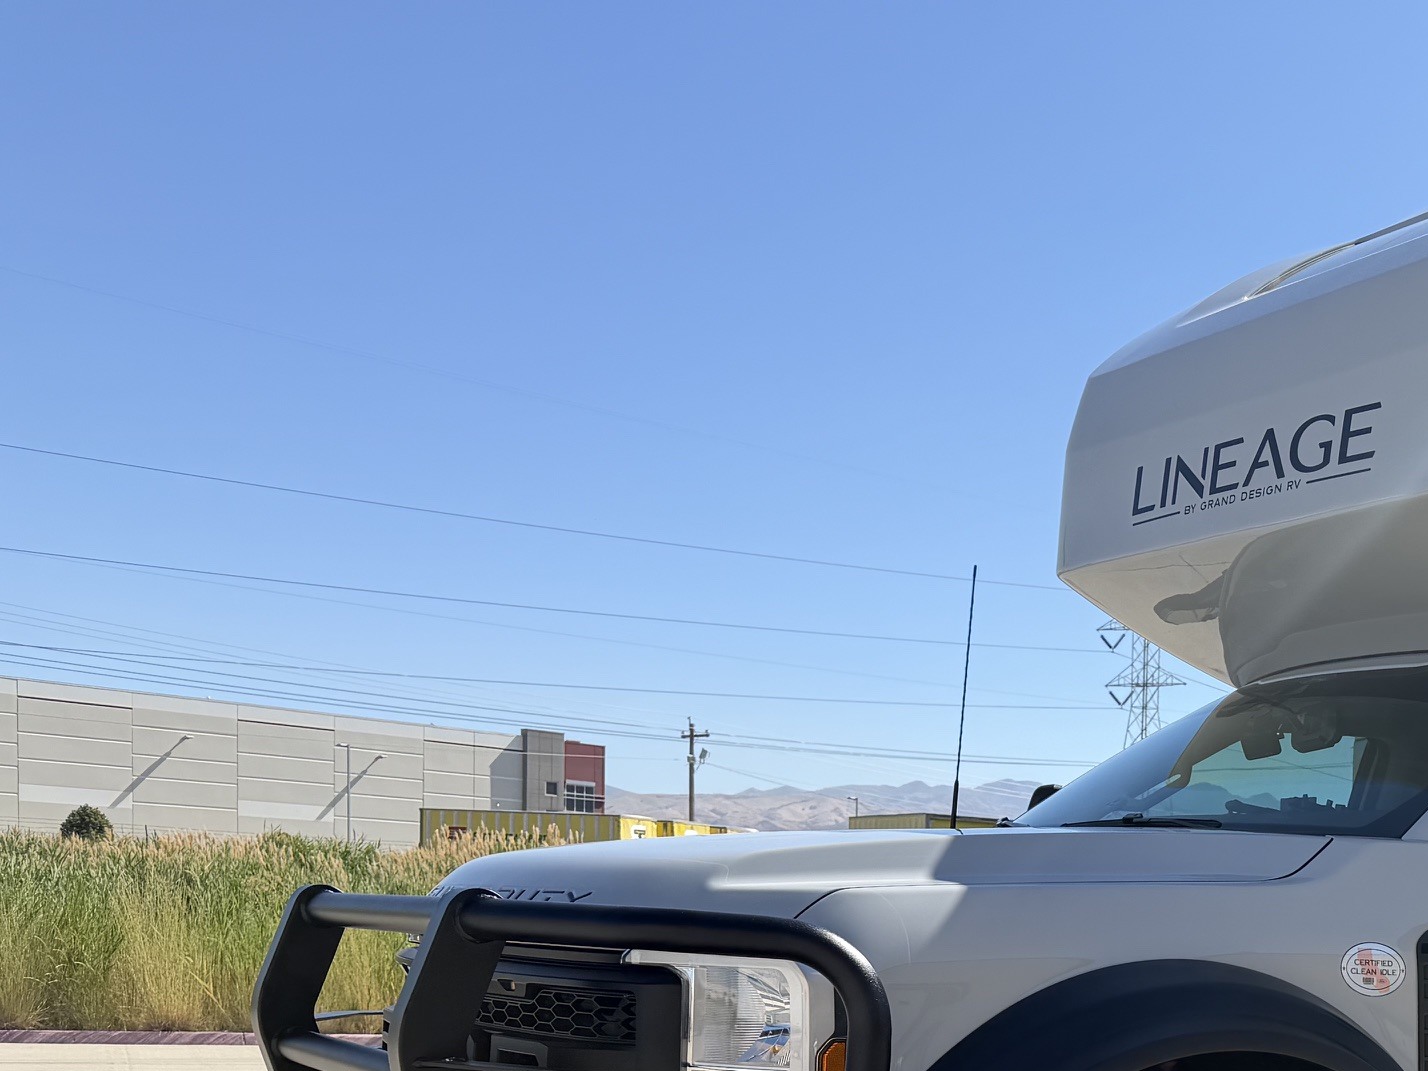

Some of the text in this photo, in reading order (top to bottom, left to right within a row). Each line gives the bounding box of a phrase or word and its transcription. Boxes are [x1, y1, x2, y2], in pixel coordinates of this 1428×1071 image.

[1132, 401, 1382, 517] LINEAGE
[1184, 479, 1301, 515] BY GRAND DESIGN RV
[1350, 967, 1377, 976] CLEAN
[1354, 959, 1393, 967] CERTIFIED
